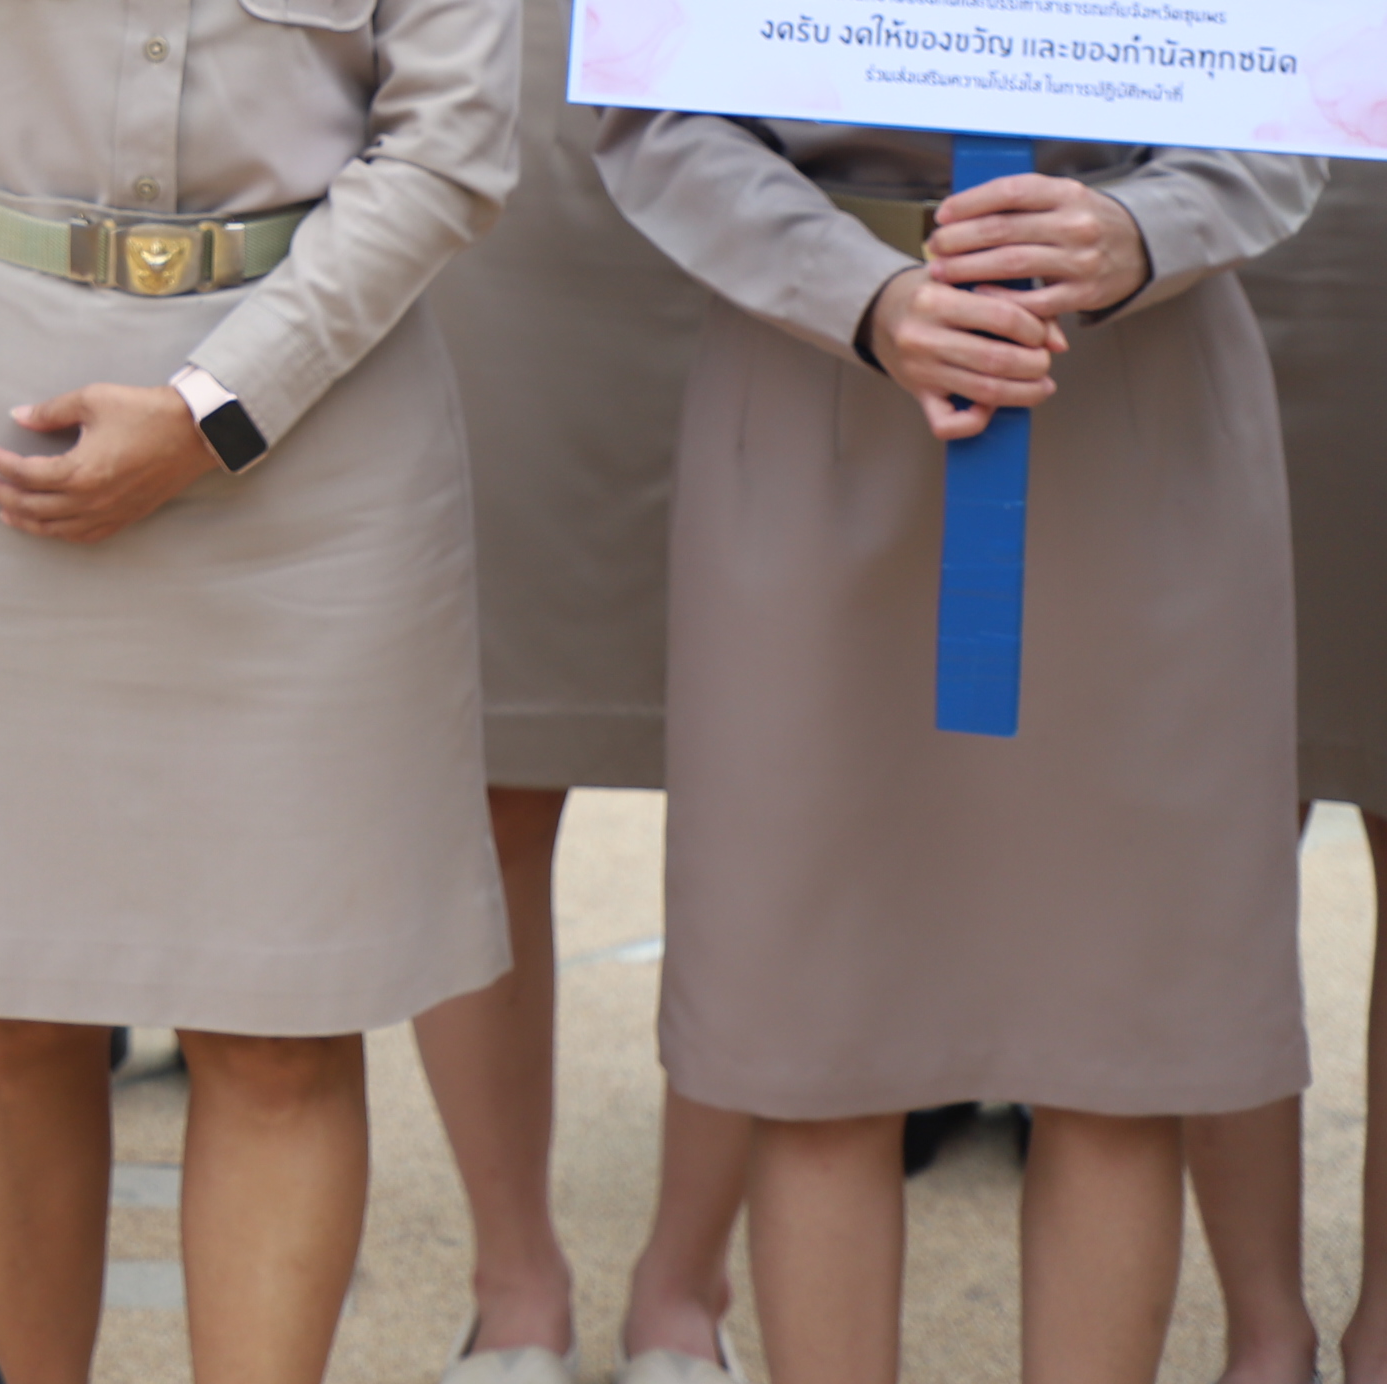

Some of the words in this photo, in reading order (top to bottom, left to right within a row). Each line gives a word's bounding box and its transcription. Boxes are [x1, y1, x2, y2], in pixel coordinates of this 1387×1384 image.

[760, 14, 831, 44] งดรับ
[838, 14, 1012, 57] งดให้ของขวัญ
[1022, 34, 1297, 78] และของกำนัลทุกชนิด
